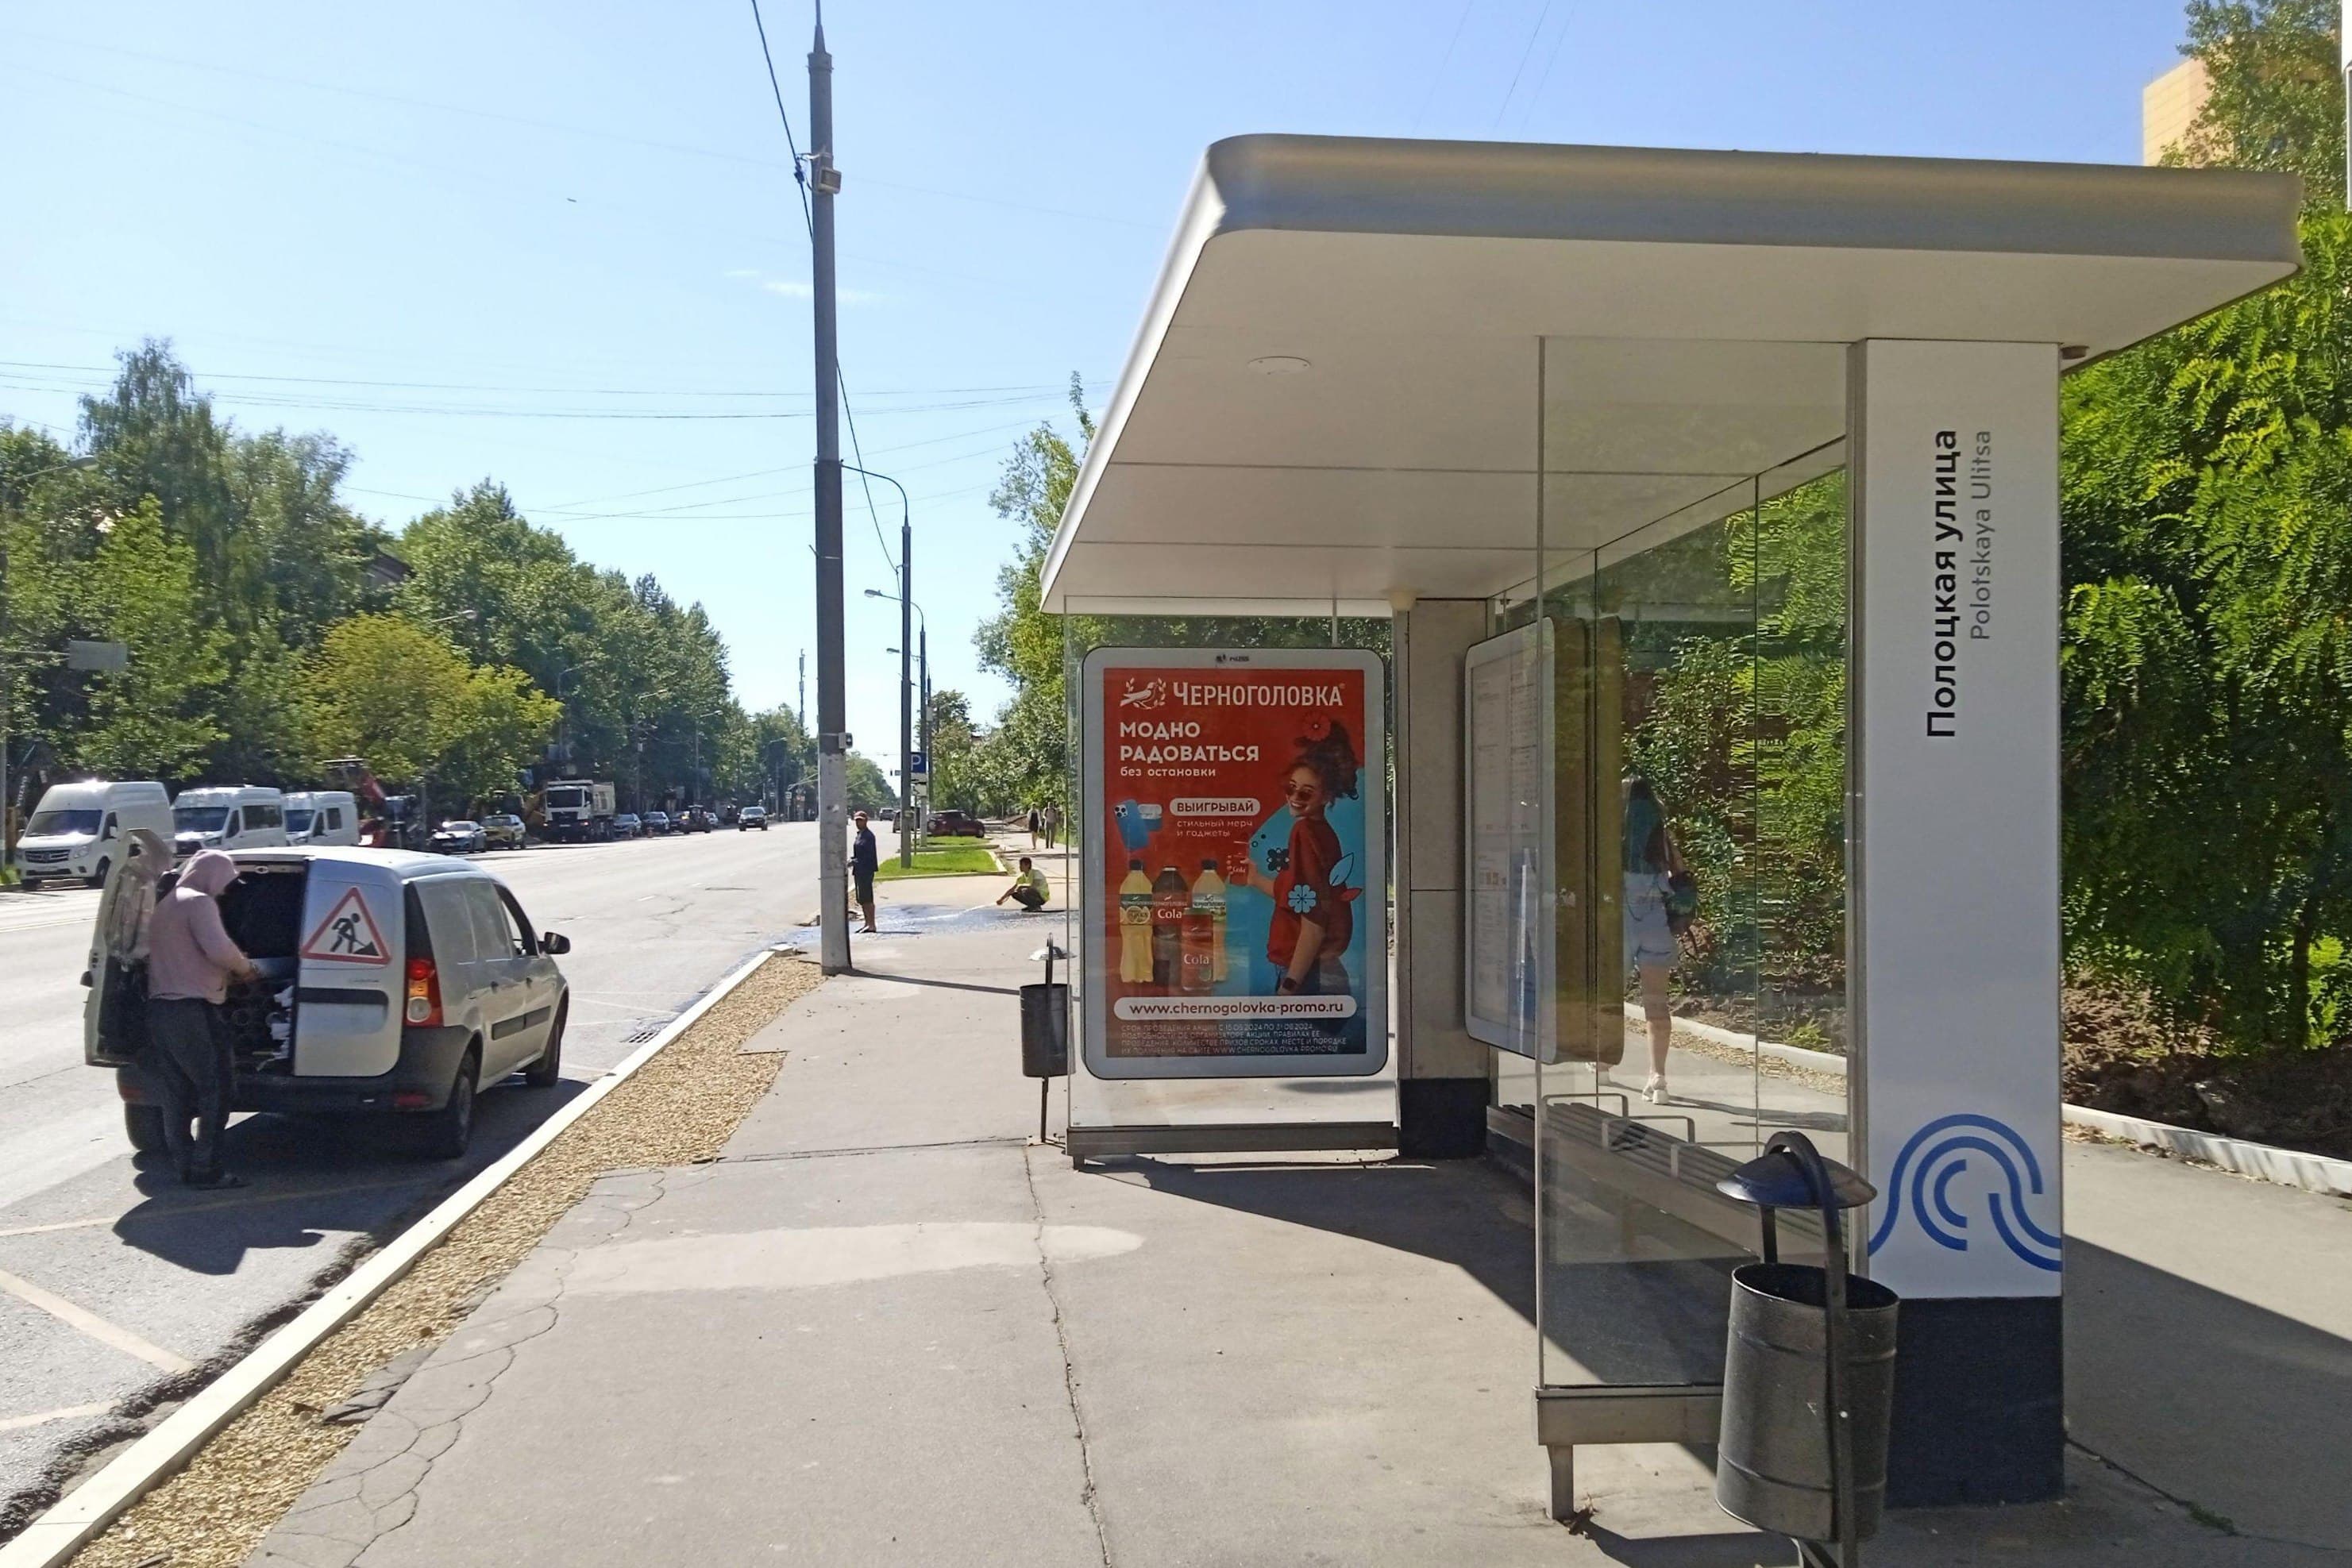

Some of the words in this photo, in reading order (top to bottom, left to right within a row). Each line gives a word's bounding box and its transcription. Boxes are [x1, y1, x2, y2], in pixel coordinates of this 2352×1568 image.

[1970, 430, 1991, 500] Ulitsa
[1934, 430, 1964, 542] улица
[1970, 508, 1996, 639] Polotskaya
[1926, 550, 1961, 738] Полоцкая
[1120, 722, 1201, 740] МОДНО
[1120, 745, 1259, 763] РАДОВАТЬСЯ
[1120, 767, 1142, 777] без
[1147, 769, 1216, 777] остановки
[1177, 800, 1254, 812] ВЫИГРЫВАЙ
[1158, 908, 1182, 919] Cola
[1183, 954, 1209, 965] Cola
[1129, 1002, 1344, 1016] www.chernogolovka-promo.ru
